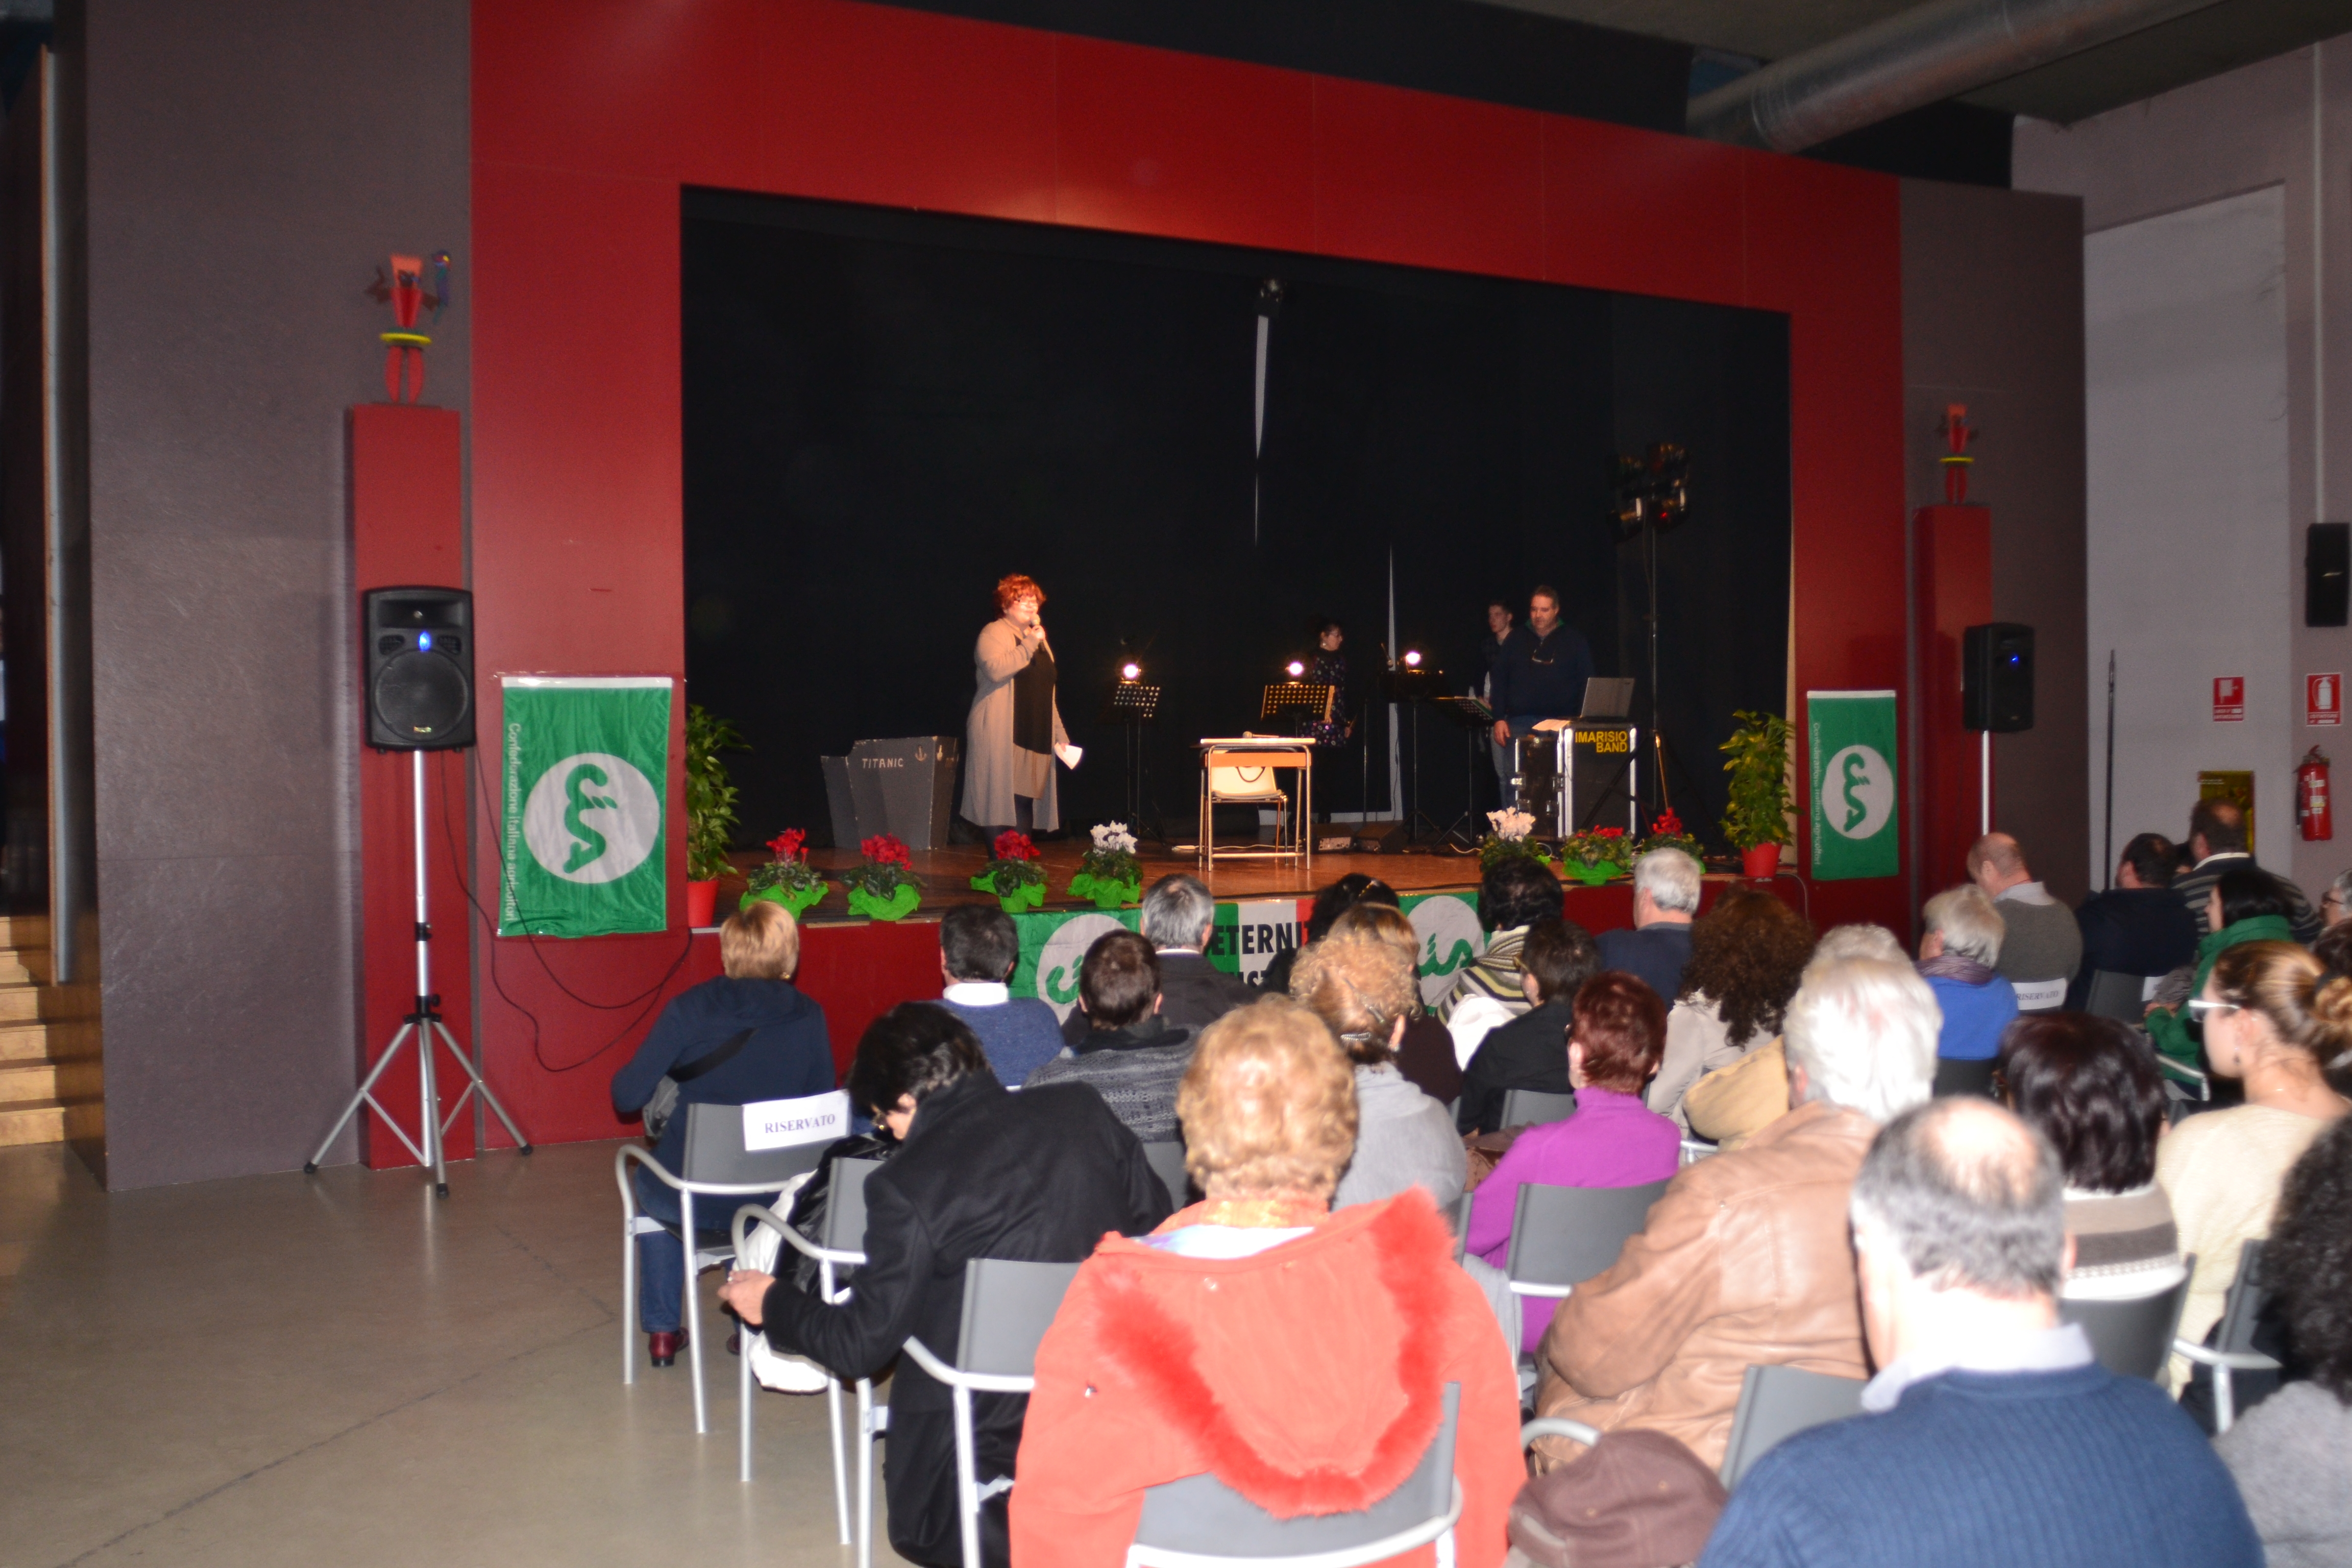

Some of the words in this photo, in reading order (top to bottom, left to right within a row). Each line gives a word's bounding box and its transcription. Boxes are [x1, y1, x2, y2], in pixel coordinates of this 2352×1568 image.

[1575, 730, 1627, 743] IMARISIO
[1596, 742, 1628, 753] BAND
[508, 723, 522, 813] Confederazione
[862, 757, 903, 769] TITANIC
[765, 1114, 836, 1133] RISERVATO
